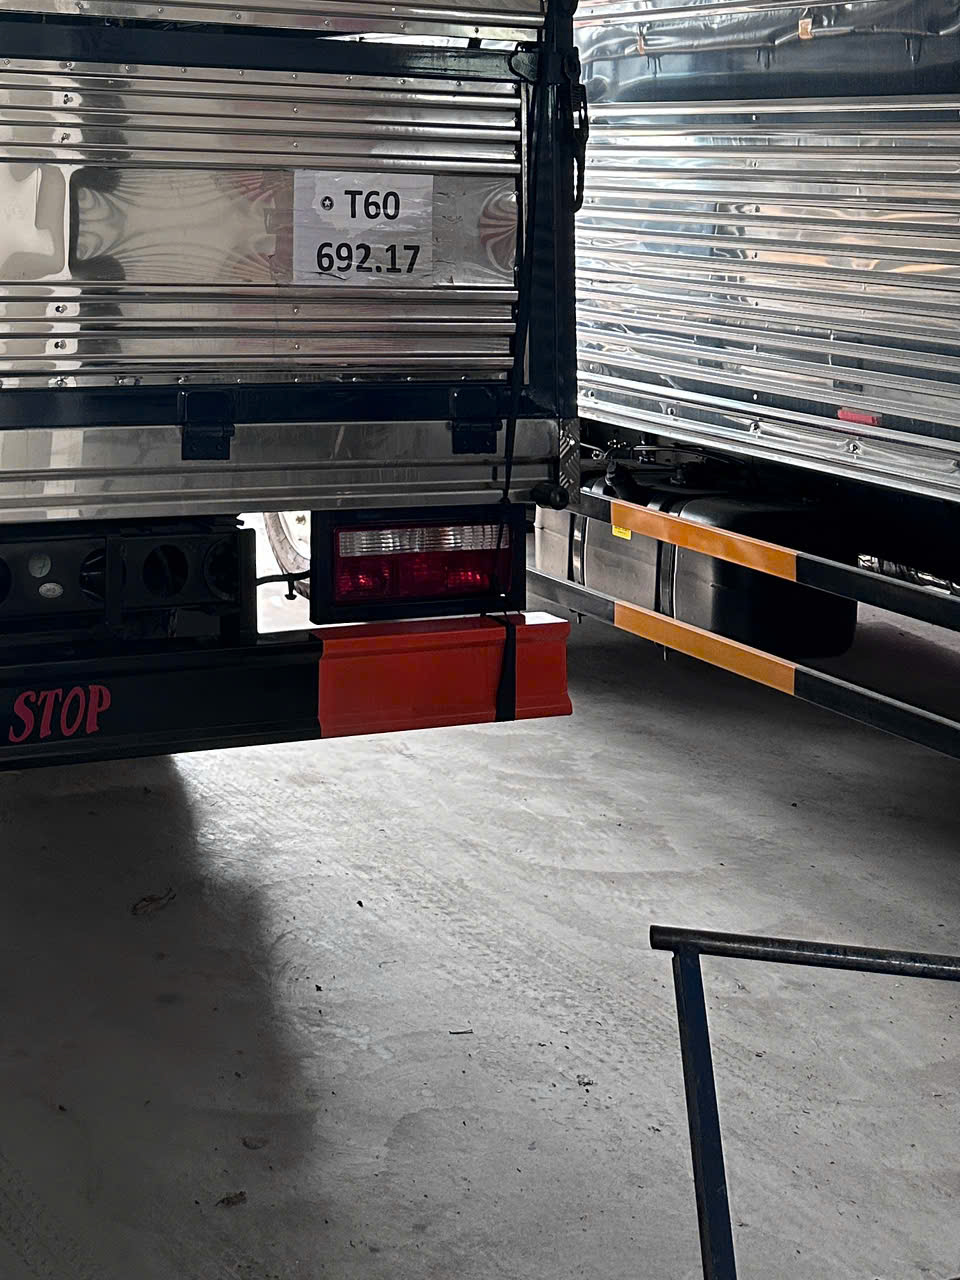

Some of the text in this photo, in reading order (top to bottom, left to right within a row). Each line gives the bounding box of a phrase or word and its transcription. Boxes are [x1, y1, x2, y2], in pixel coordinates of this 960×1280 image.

[344, 190, 401, 220] T60
[316, 242, 421, 274] 692.17
[8, 684, 112, 743] STOP
